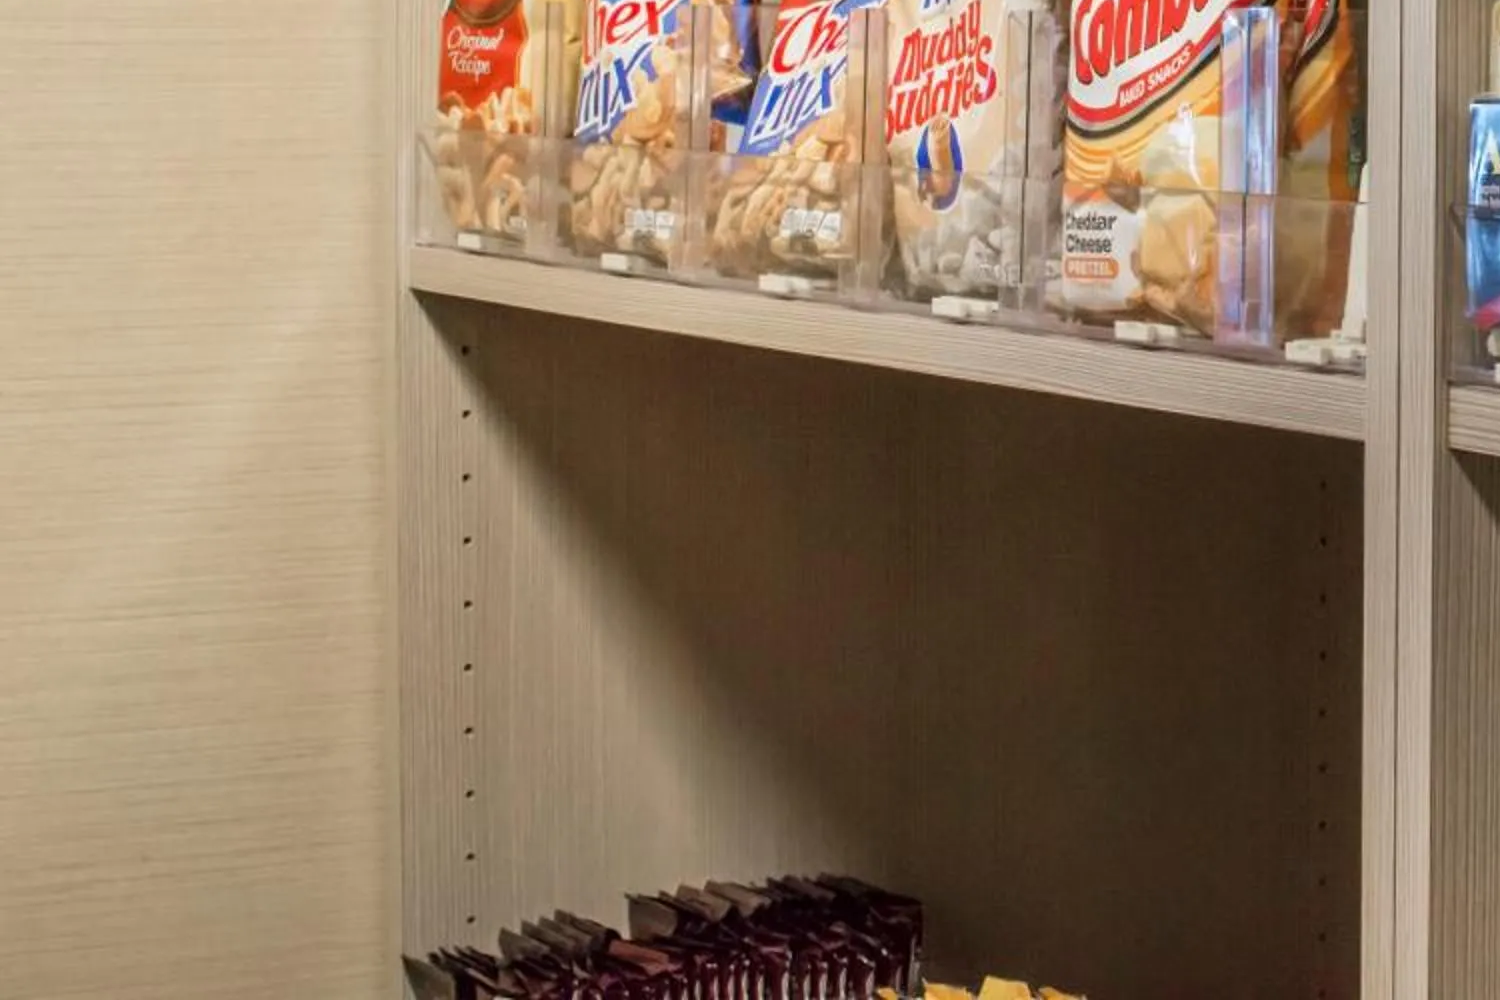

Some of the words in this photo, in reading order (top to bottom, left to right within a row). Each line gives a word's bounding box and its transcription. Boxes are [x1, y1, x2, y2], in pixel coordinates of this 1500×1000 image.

[447, 26, 504, 54] Original
[1147, 48, 1192, 91] SNACKS
[1066, 233, 1113, 254] Cheese
